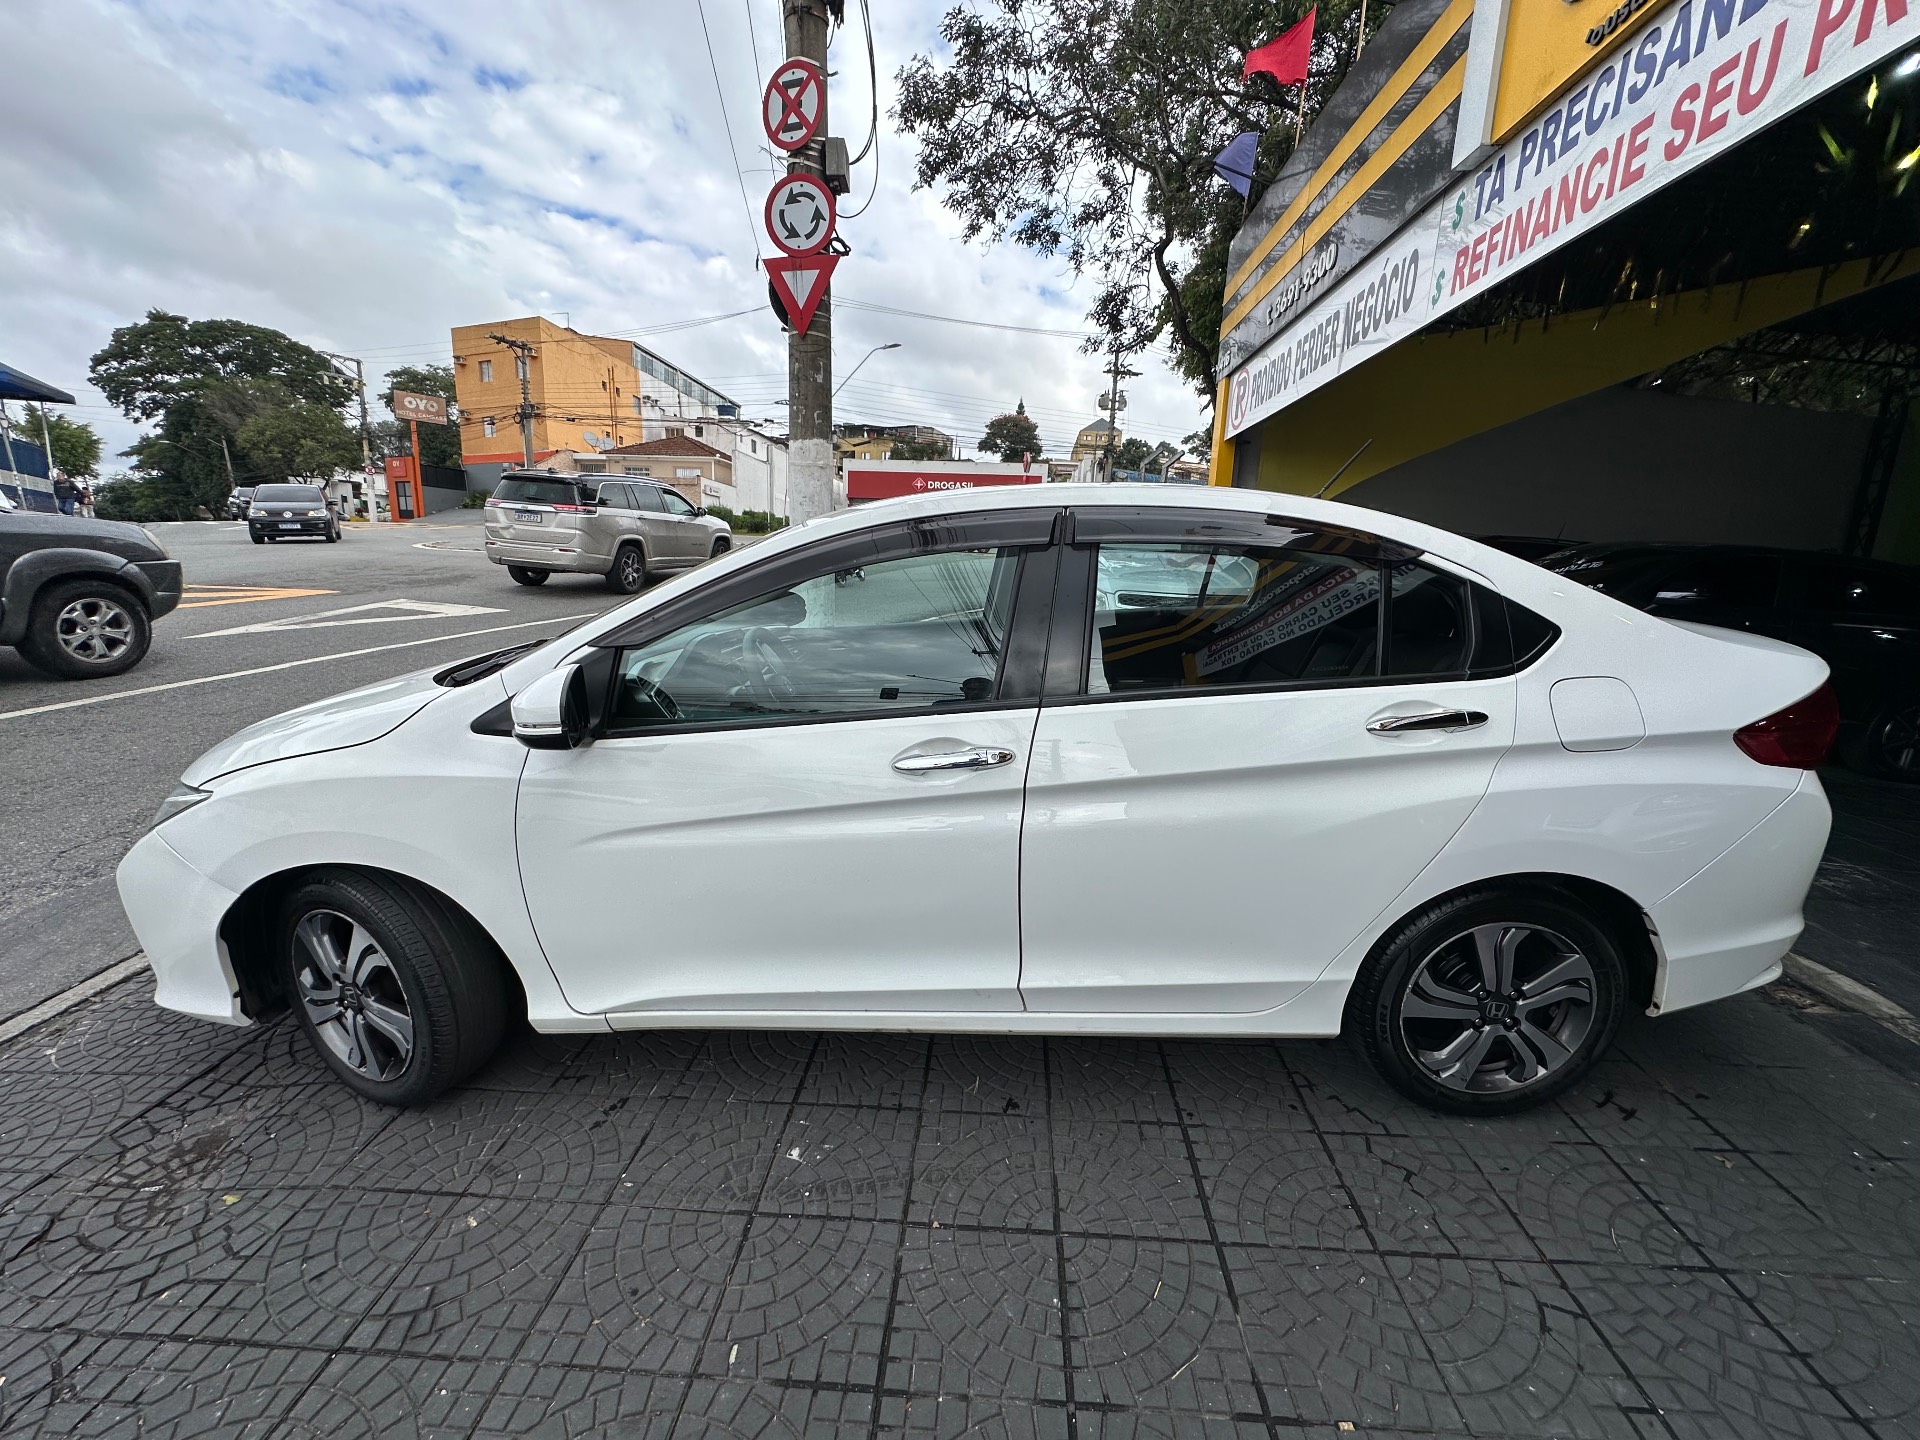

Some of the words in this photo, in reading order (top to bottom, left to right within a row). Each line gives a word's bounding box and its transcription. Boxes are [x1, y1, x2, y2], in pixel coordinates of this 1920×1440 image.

[1449, 111, 1656, 296] REFINANCIE
[1664, 18, 1789, 162] SEU
[1474, 153, 1507, 222] TA
[1250, 346, 1292, 412] PROIBIDO
[1292, 310, 1341, 384] PERDER
[1341, 249, 1420, 353] NEGÓCIO
[404, 396, 438, 412] OYO
